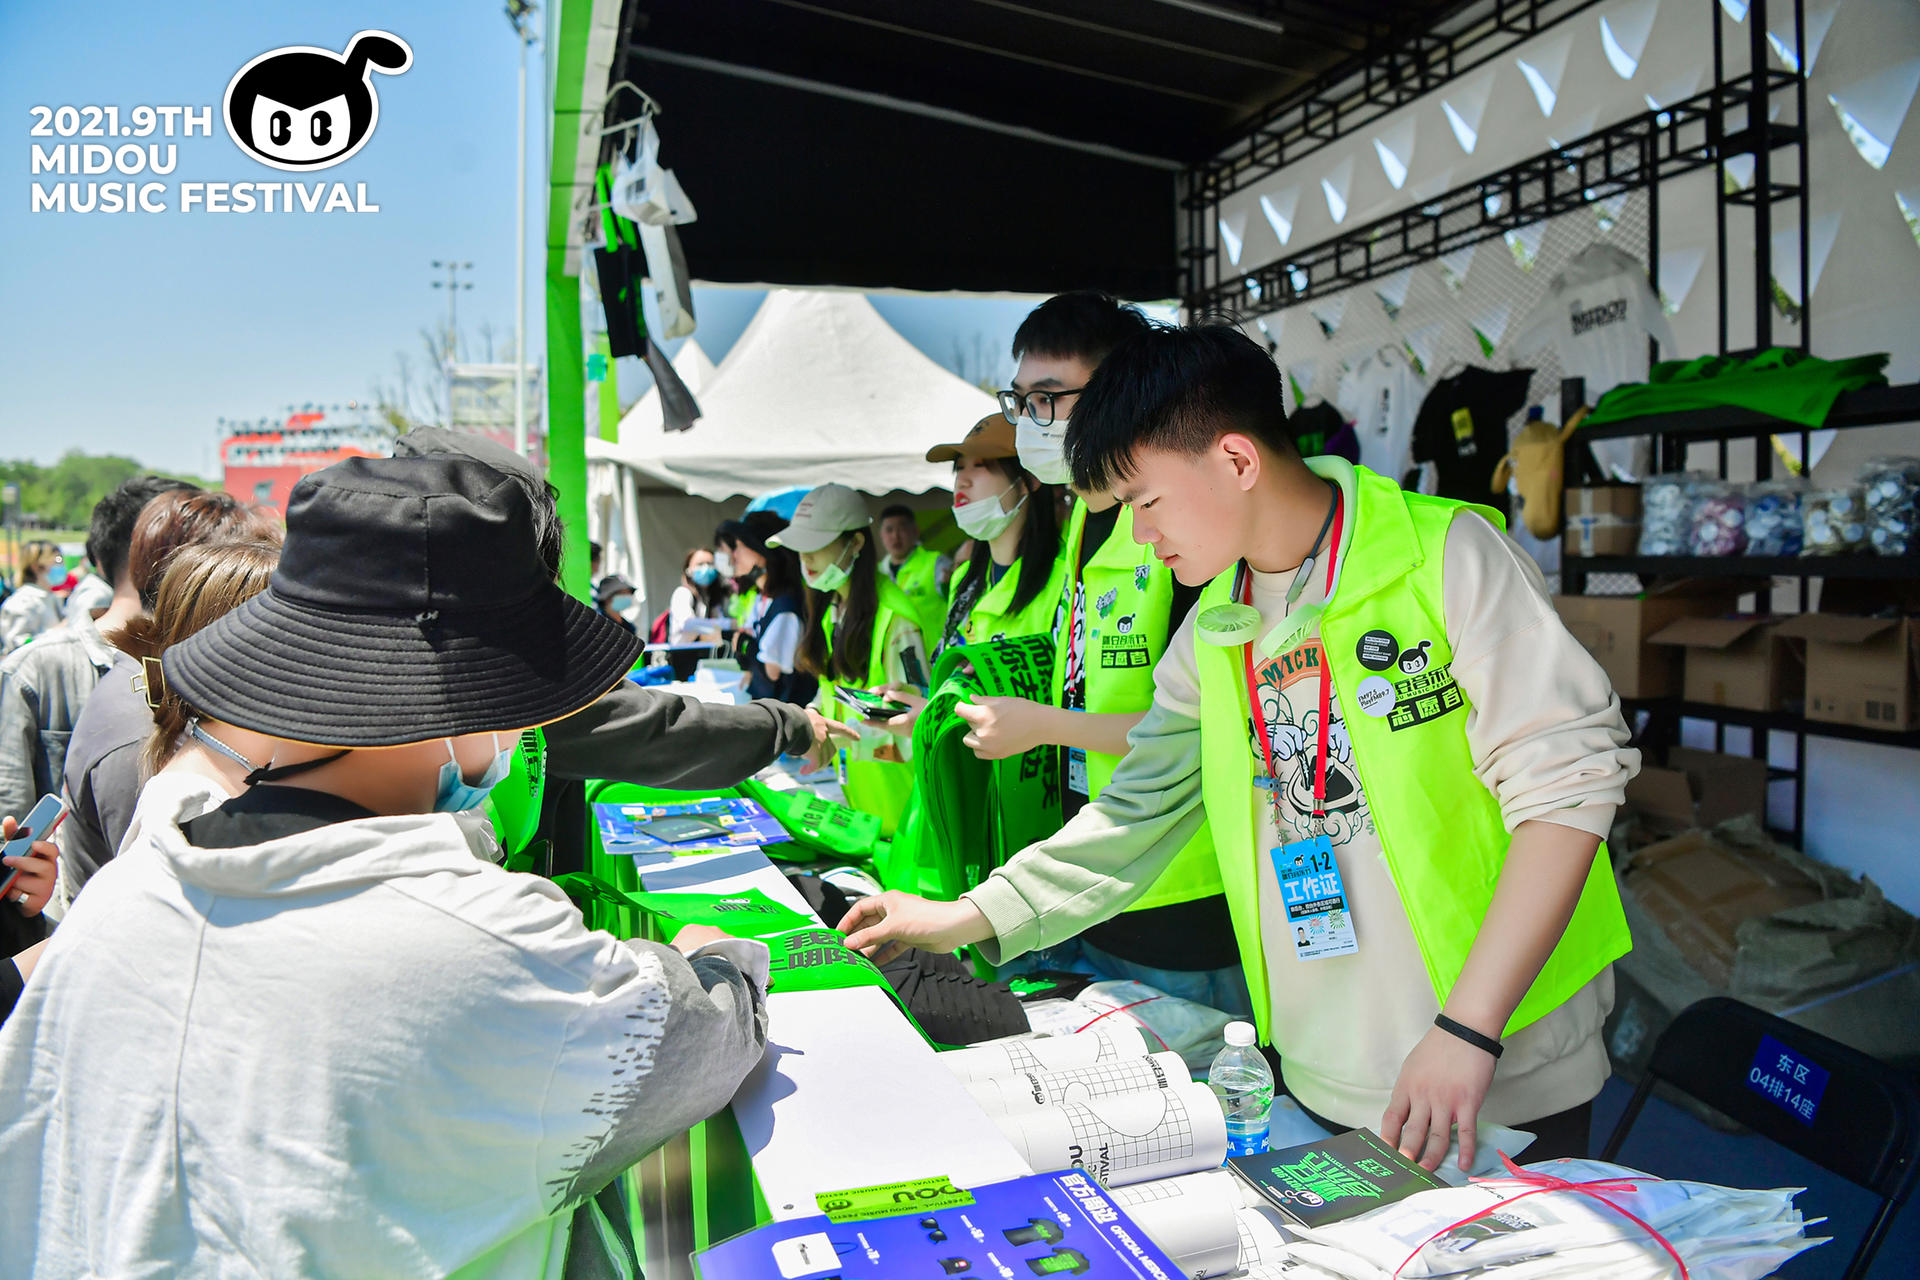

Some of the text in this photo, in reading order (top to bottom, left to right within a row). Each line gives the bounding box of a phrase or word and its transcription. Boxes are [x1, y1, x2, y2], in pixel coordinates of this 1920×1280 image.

[1390, 686, 1462, 727] 志愿者
[1407, 687, 1431, 698] MUSIC
[1310, 851, 1332, 872] 1-2
[1284, 872, 1341, 902] 工作证
[1776, 1054, 1811, 1085] 东区
[1750, 1067, 1816, 1120] 04排14座
[1059, 1172, 1119, 1225] 官方周边
[1110, 1225, 1144, 1258] OFFICIAL
